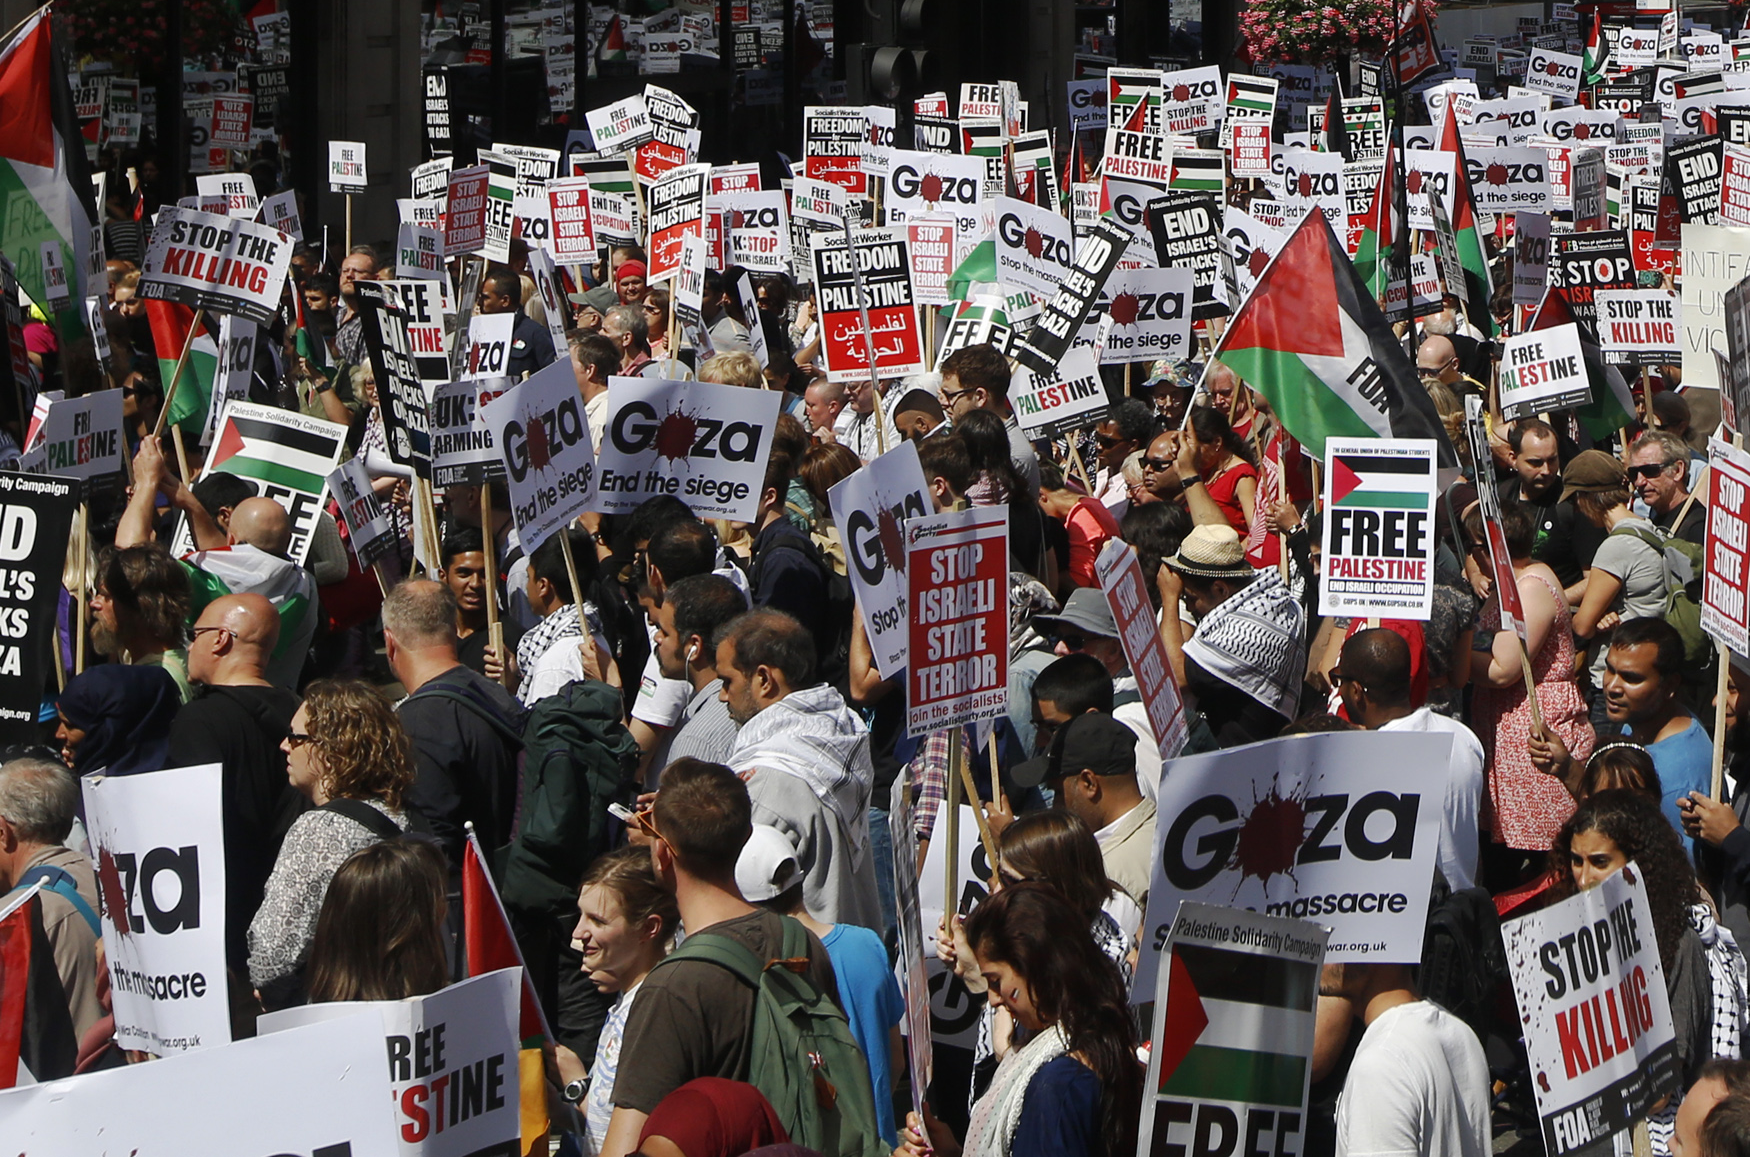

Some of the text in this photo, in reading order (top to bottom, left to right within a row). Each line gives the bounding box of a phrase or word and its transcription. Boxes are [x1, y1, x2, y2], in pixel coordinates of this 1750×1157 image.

[1470, 45, 1488, 55] END
[1620, 35, 1656, 51] Gza
[1531, 54, 1578, 80] Gza
[609, 107, 628, 123] FREE
[650, 99, 692, 126] FREEDOM
[838, 108, 861, 117] Worker
[1168, 114, 1209, 131] KILLING
[1187, 104, 1207, 118] THE
[810, 116, 863, 135] FREEDOM
[1235, 136, 1269, 148] ISRAELI
[1104, 158, 1169, 180] PALESTINE
[1235, 155, 1269, 169] TERROR
[416, 175, 447, 195] FREEDOM
[1487, 191, 1546, 204] the siege
[556, 192, 580, 206] STOP
[795, 193, 844, 218] PALESTINE
[452, 210, 481, 229] STATE
[554, 206, 587, 222] ISRAELI
[1163, 212, 1212, 239] END
[170, 217, 234, 249] STOP
[558, 221, 586, 237] STATE
[863, 233, 893, 243] Worker
[917, 224, 944, 243] STOP
[556, 235, 591, 252] TERROR
[161, 247, 270, 296] KILLING
[915, 257, 947, 276] STATE
[141, 281, 165, 300] FOA
[1607, 299, 1674, 321] STOP THE
[1141, 331, 1183, 353] siege
[1609, 319, 1676, 345] KILLING
[1510, 342, 1545, 363] FREE
[1016, 368, 1099, 417] PALESTINE
[229, 404, 343, 439] Palestine Solidarity Campaign
[435, 392, 475, 426] UK:
[47, 429, 118, 471] PALESTINE
[433, 433, 493, 460] ARMING
[15, 479, 70, 496] Campaign
[599, 469, 750, 501] End the siege
[516, 486, 557, 529] End the
[917, 523, 948, 532] Socialist
[1330, 509, 1427, 558] FREE
[1710, 506, 1750, 552] ISRAELI
[931, 543, 983, 585] STOP
[1329, 558, 1426, 580] PALESTINE
[1711, 544, 1745, 587] STATE
[1114, 575, 1142, 611] STOP
[1329, 581, 1424, 595] END ISRAELI OCCUPATION
[1707, 575, 1747, 625] TERROR
[919, 578, 995, 625] ISRAELI
[1369, 599, 1424, 608] WWW.GUPSUK.CO.UK
[917, 653, 997, 702] TERROR
[909, 691, 1007, 726] join socialists!
[910, 706, 1006, 734] www.socialistparty.org.uk
[1161, 789, 1422, 891] Gza
[1266, 891, 1408, 920] massacre
[1175, 917, 1282, 953] Palestine Solidarity
[1610, 897, 1644, 965] THE
[1555, 963, 1653, 1081] KILLING
[1150, 1099, 1305, 1157] FREE
[1552, 1107, 1592, 1156] FOA
